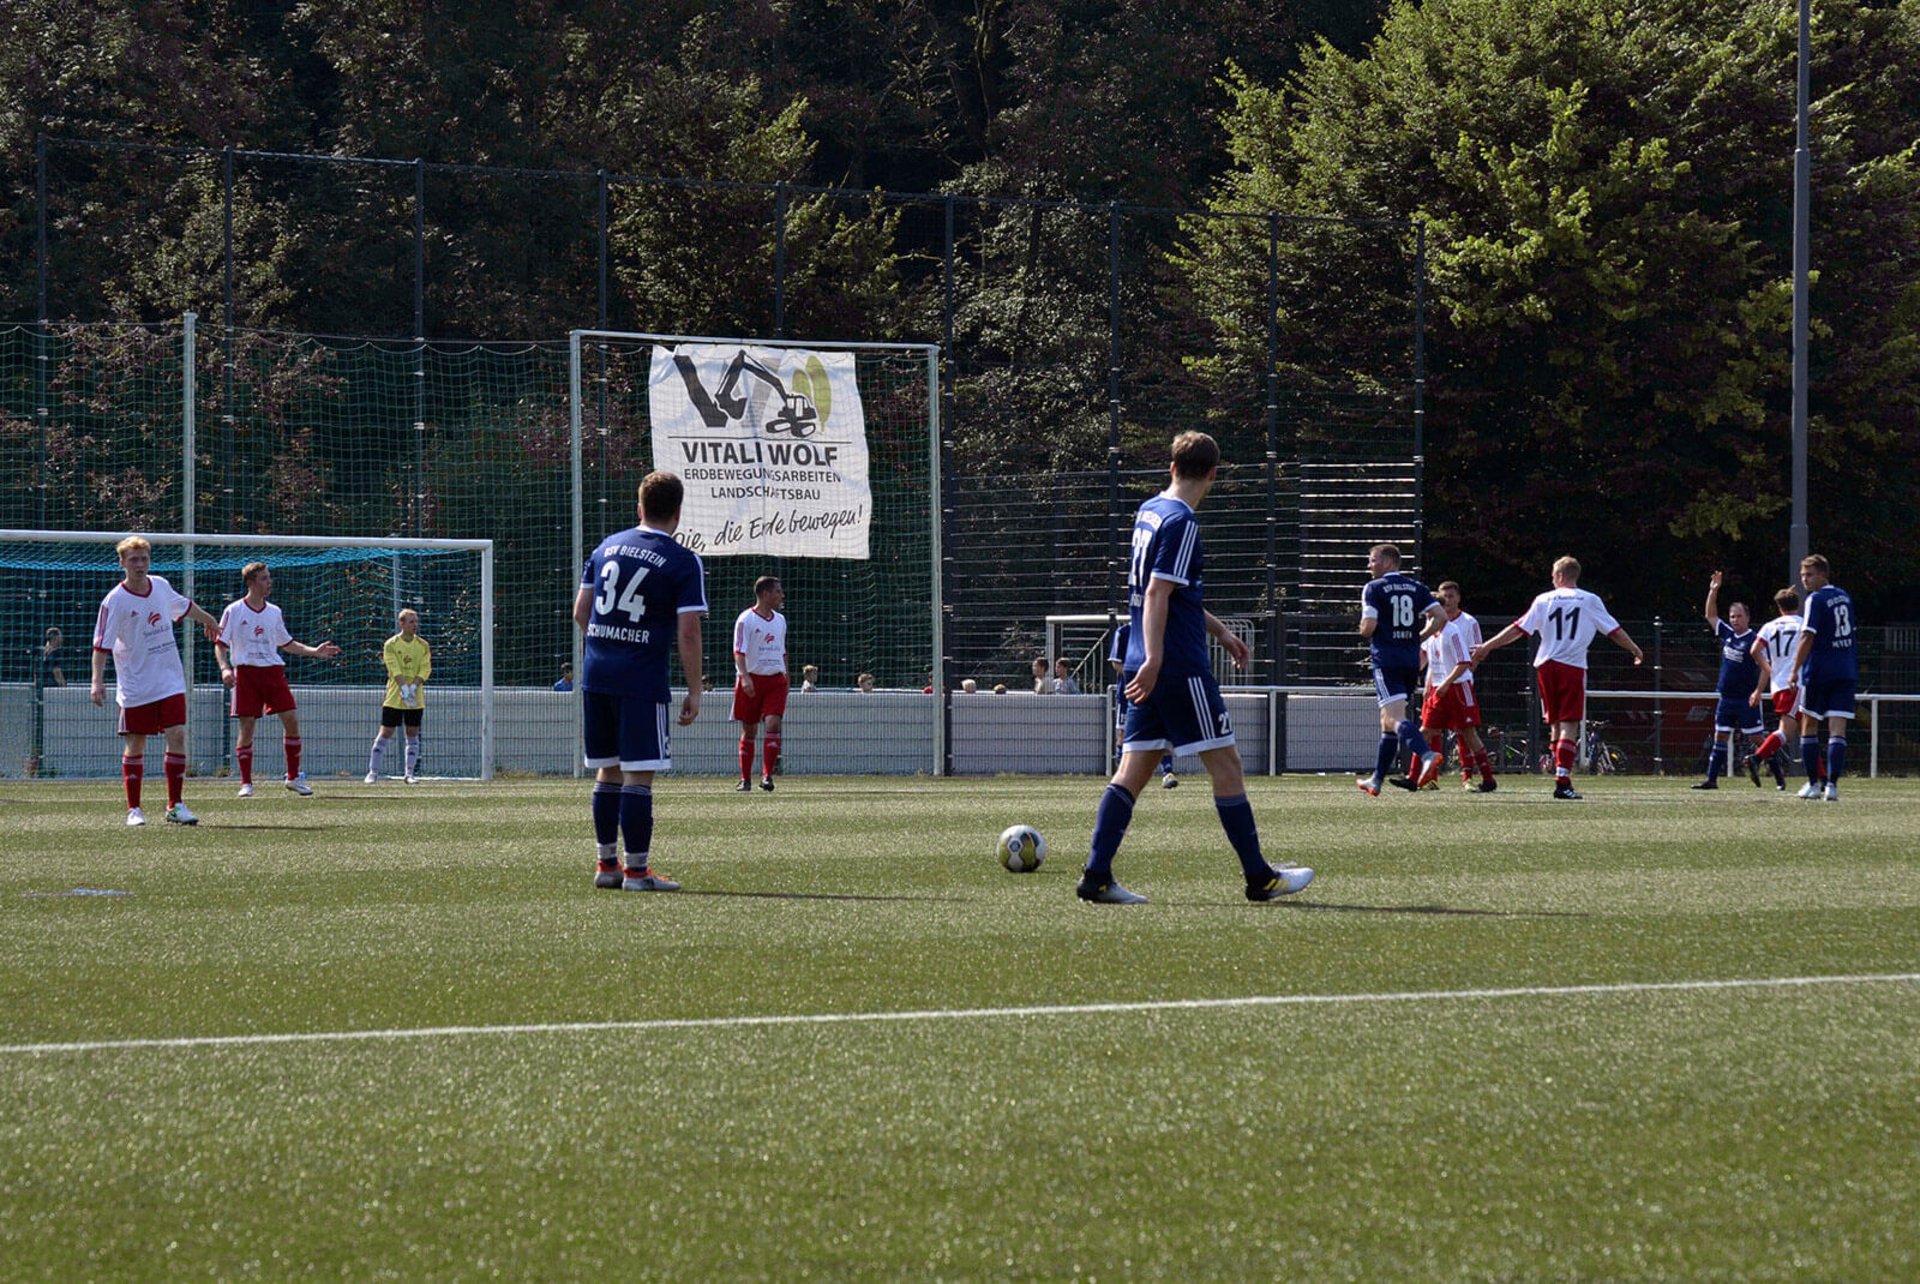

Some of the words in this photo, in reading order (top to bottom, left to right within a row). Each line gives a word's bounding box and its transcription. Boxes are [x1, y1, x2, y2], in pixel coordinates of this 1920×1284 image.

[682, 441, 763, 464] VITALI
[767, 443, 838, 467] WOLF
[714, 520, 744, 545] die
[750, 511, 787, 539] Erde
[790, 504, 863, 540] bewegen!
[619, 545, 668, 568] BIELSTEIN
[594, 560, 650, 623] 34
[1390, 594, 1414, 627] 18
[1548, 606, 1581, 641] 11
[1833, 603, 1852, 638] 13
[587, 623, 651, 645] SCHUMACHER
[1770, 629, 1797, 658] 17
